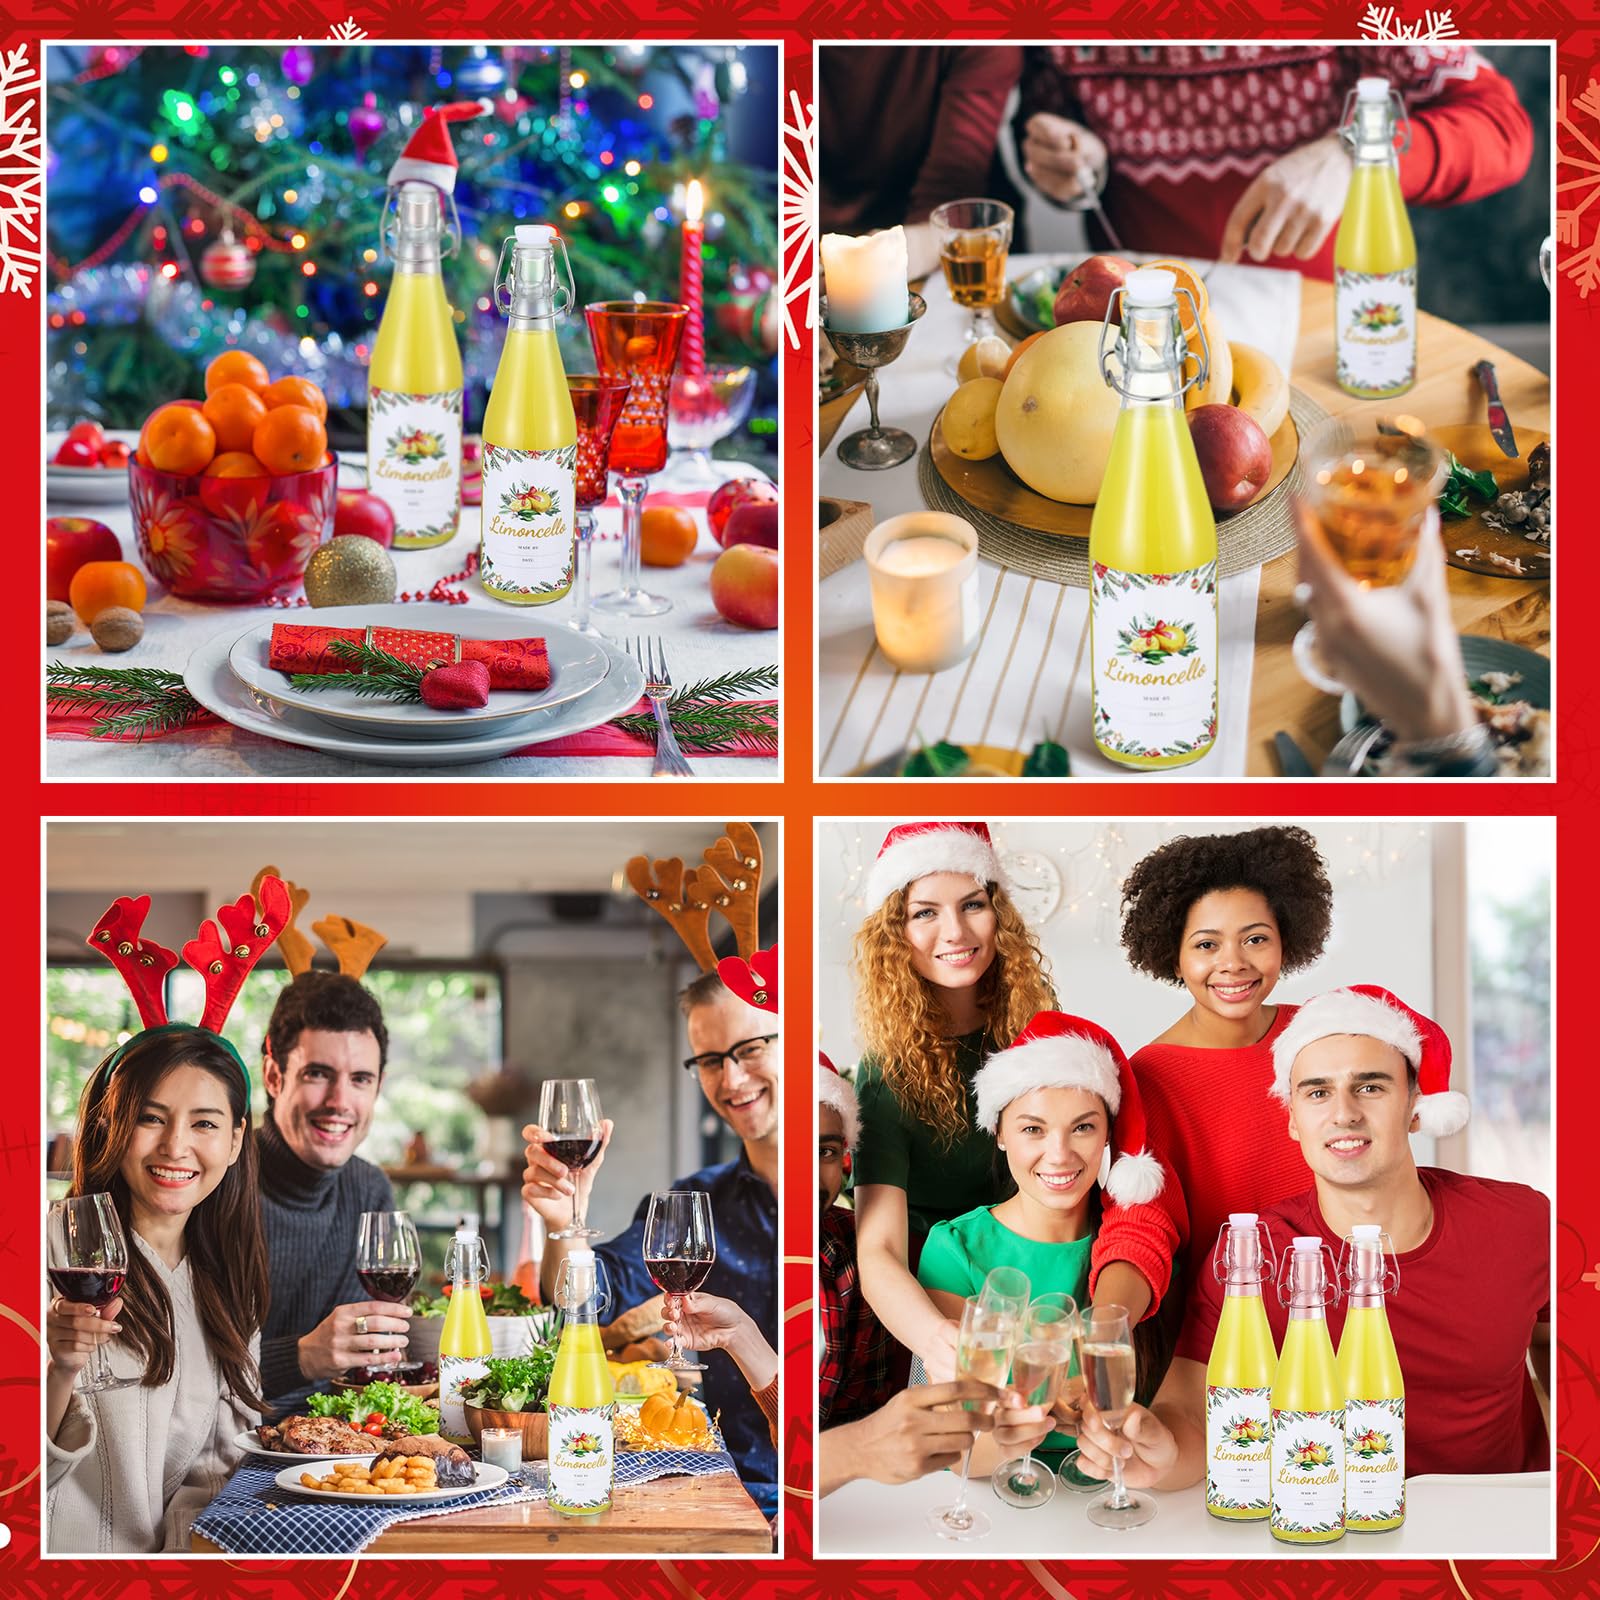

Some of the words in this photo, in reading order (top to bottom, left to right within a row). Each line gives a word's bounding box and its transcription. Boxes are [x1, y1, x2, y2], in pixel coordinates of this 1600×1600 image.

[489, 515, 567, 538] Limoncello
[1104, 657, 1207, 686] Limoncello
[554, 1453, 608, 1469] Limoncello
[1213, 1444, 1271, 1461] Limoncell
[1345, 1456, 1399, 1473] imoncello
[1277, 1468, 1340, 1485] Limoncello
